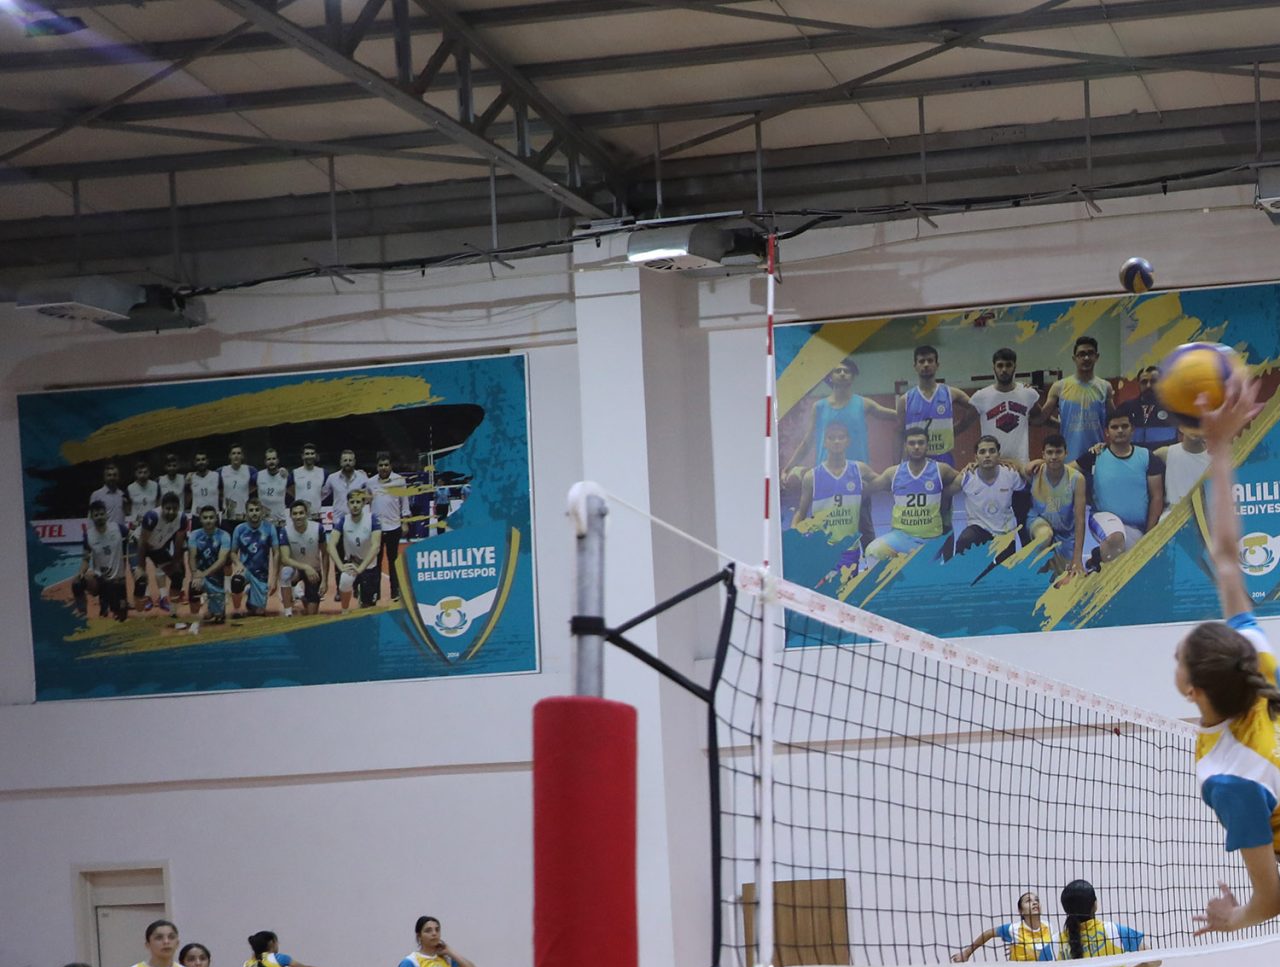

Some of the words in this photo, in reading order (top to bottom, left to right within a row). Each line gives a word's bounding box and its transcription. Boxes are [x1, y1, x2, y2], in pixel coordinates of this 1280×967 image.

[906, 493, 927, 508] 20
[416, 546, 496, 569] HALİLİYE
[417, 567, 497, 581] BELEDİYESPOR
